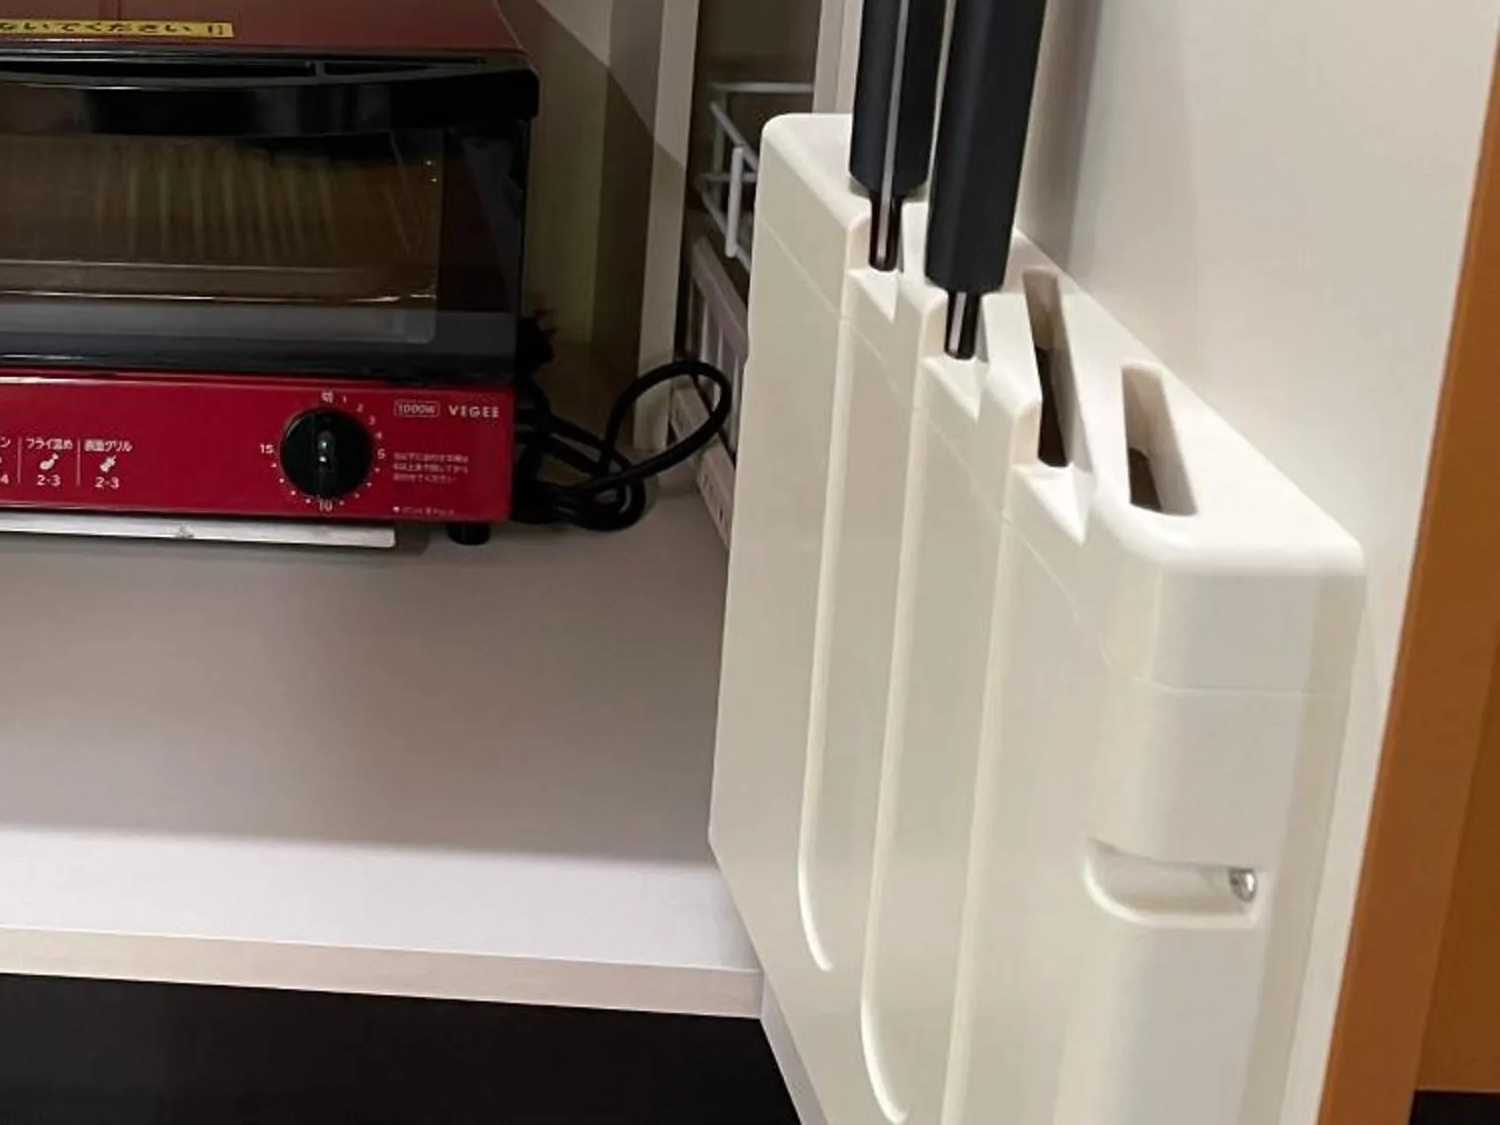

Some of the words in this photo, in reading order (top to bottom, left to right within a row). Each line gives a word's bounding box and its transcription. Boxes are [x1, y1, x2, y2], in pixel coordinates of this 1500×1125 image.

[259, 442, 275, 455] 15
[377, 448, 386, 460] 5
[319, 498, 333, 512] 10
